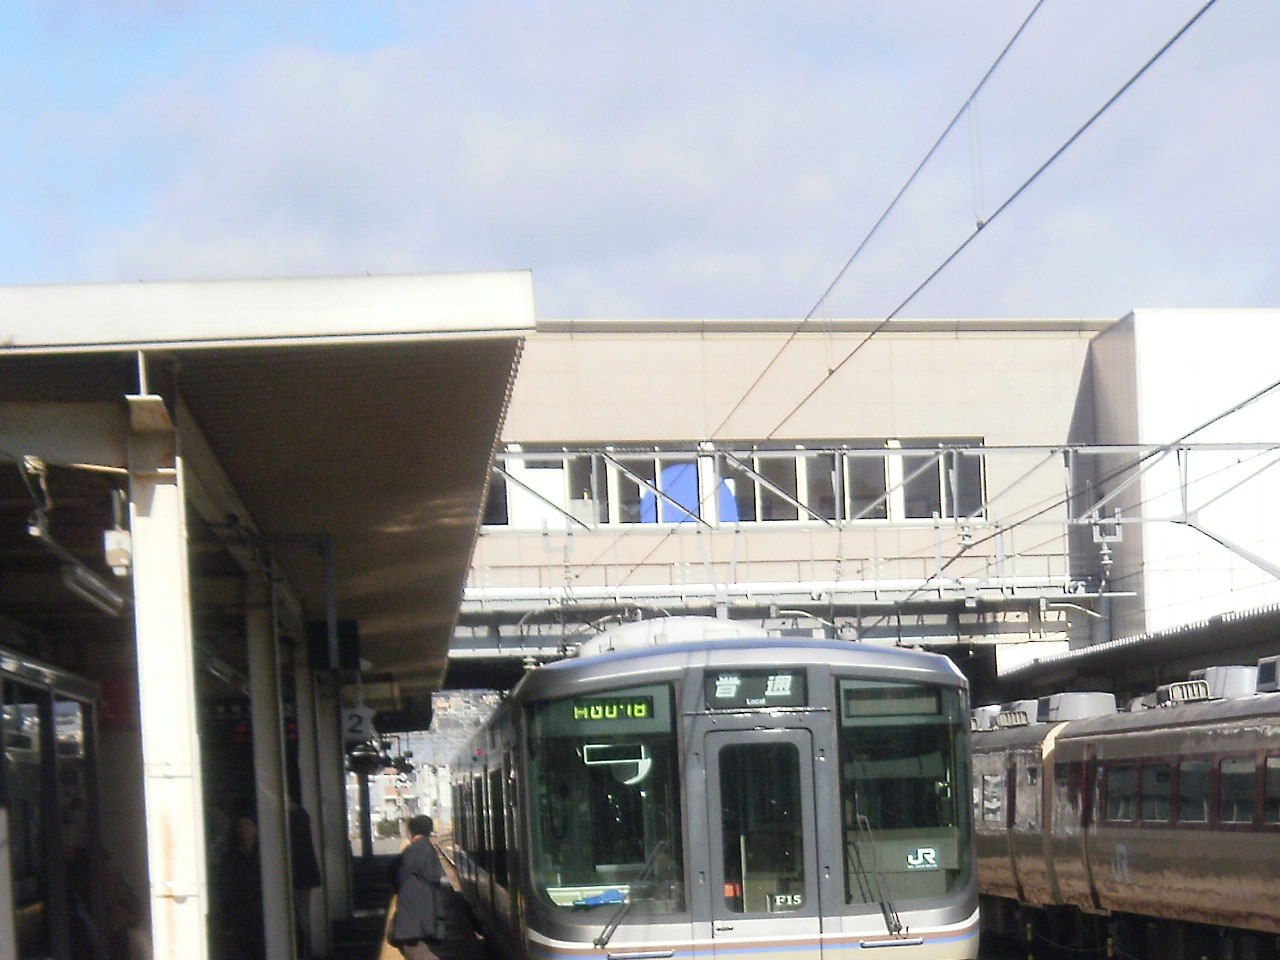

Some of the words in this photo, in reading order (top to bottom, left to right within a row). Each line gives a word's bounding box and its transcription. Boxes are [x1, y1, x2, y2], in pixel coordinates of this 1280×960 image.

[715, 675, 792, 698] 普通
[745, 697, 766, 706] Local
[349, 712, 364, 734] 2
[907, 847, 937, 865] JR
